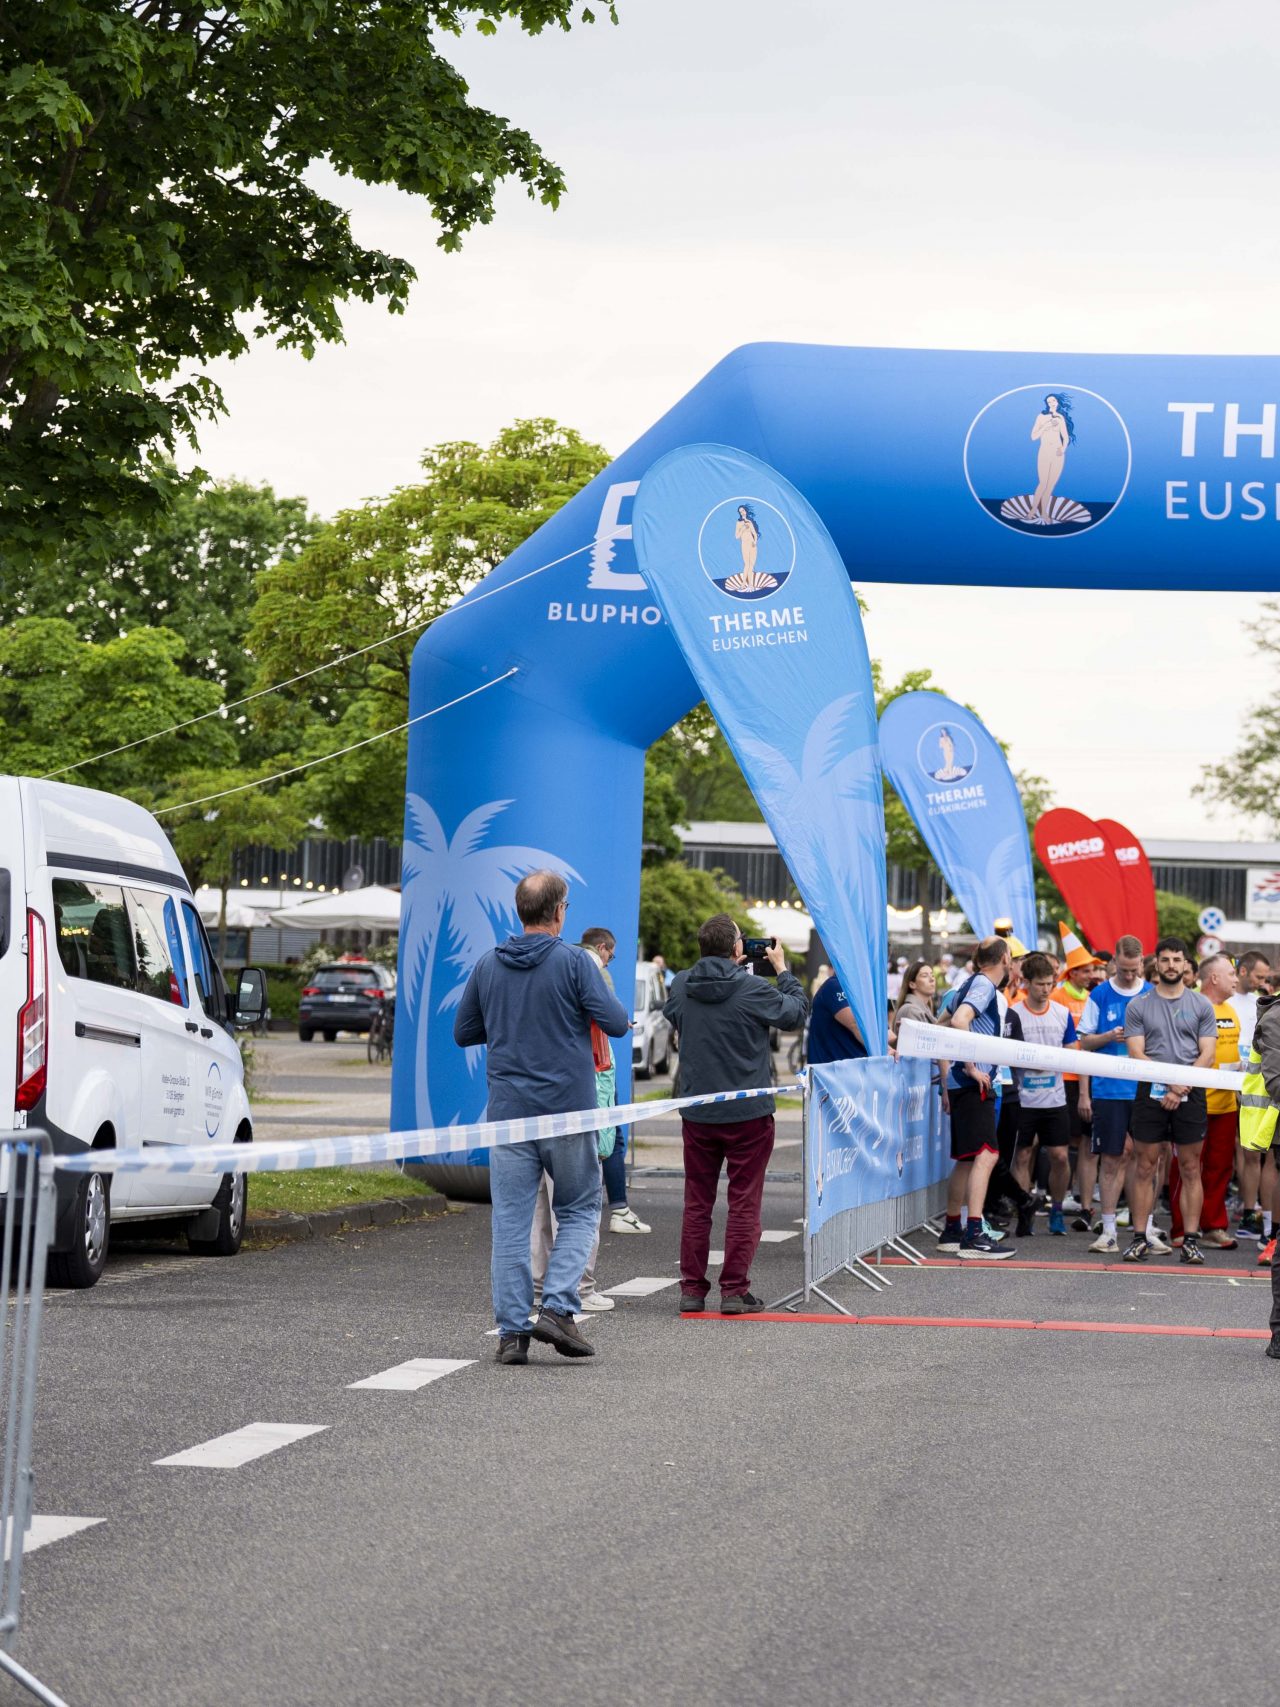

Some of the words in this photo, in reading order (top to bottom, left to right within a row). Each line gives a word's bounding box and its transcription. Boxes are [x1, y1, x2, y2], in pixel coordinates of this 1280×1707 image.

[547, 602, 668, 625] BLUPHO
[710, 606, 806, 634] THERME
[712, 630, 809, 652] EUSKIRCHEN
[926, 785, 985, 806] THERME
